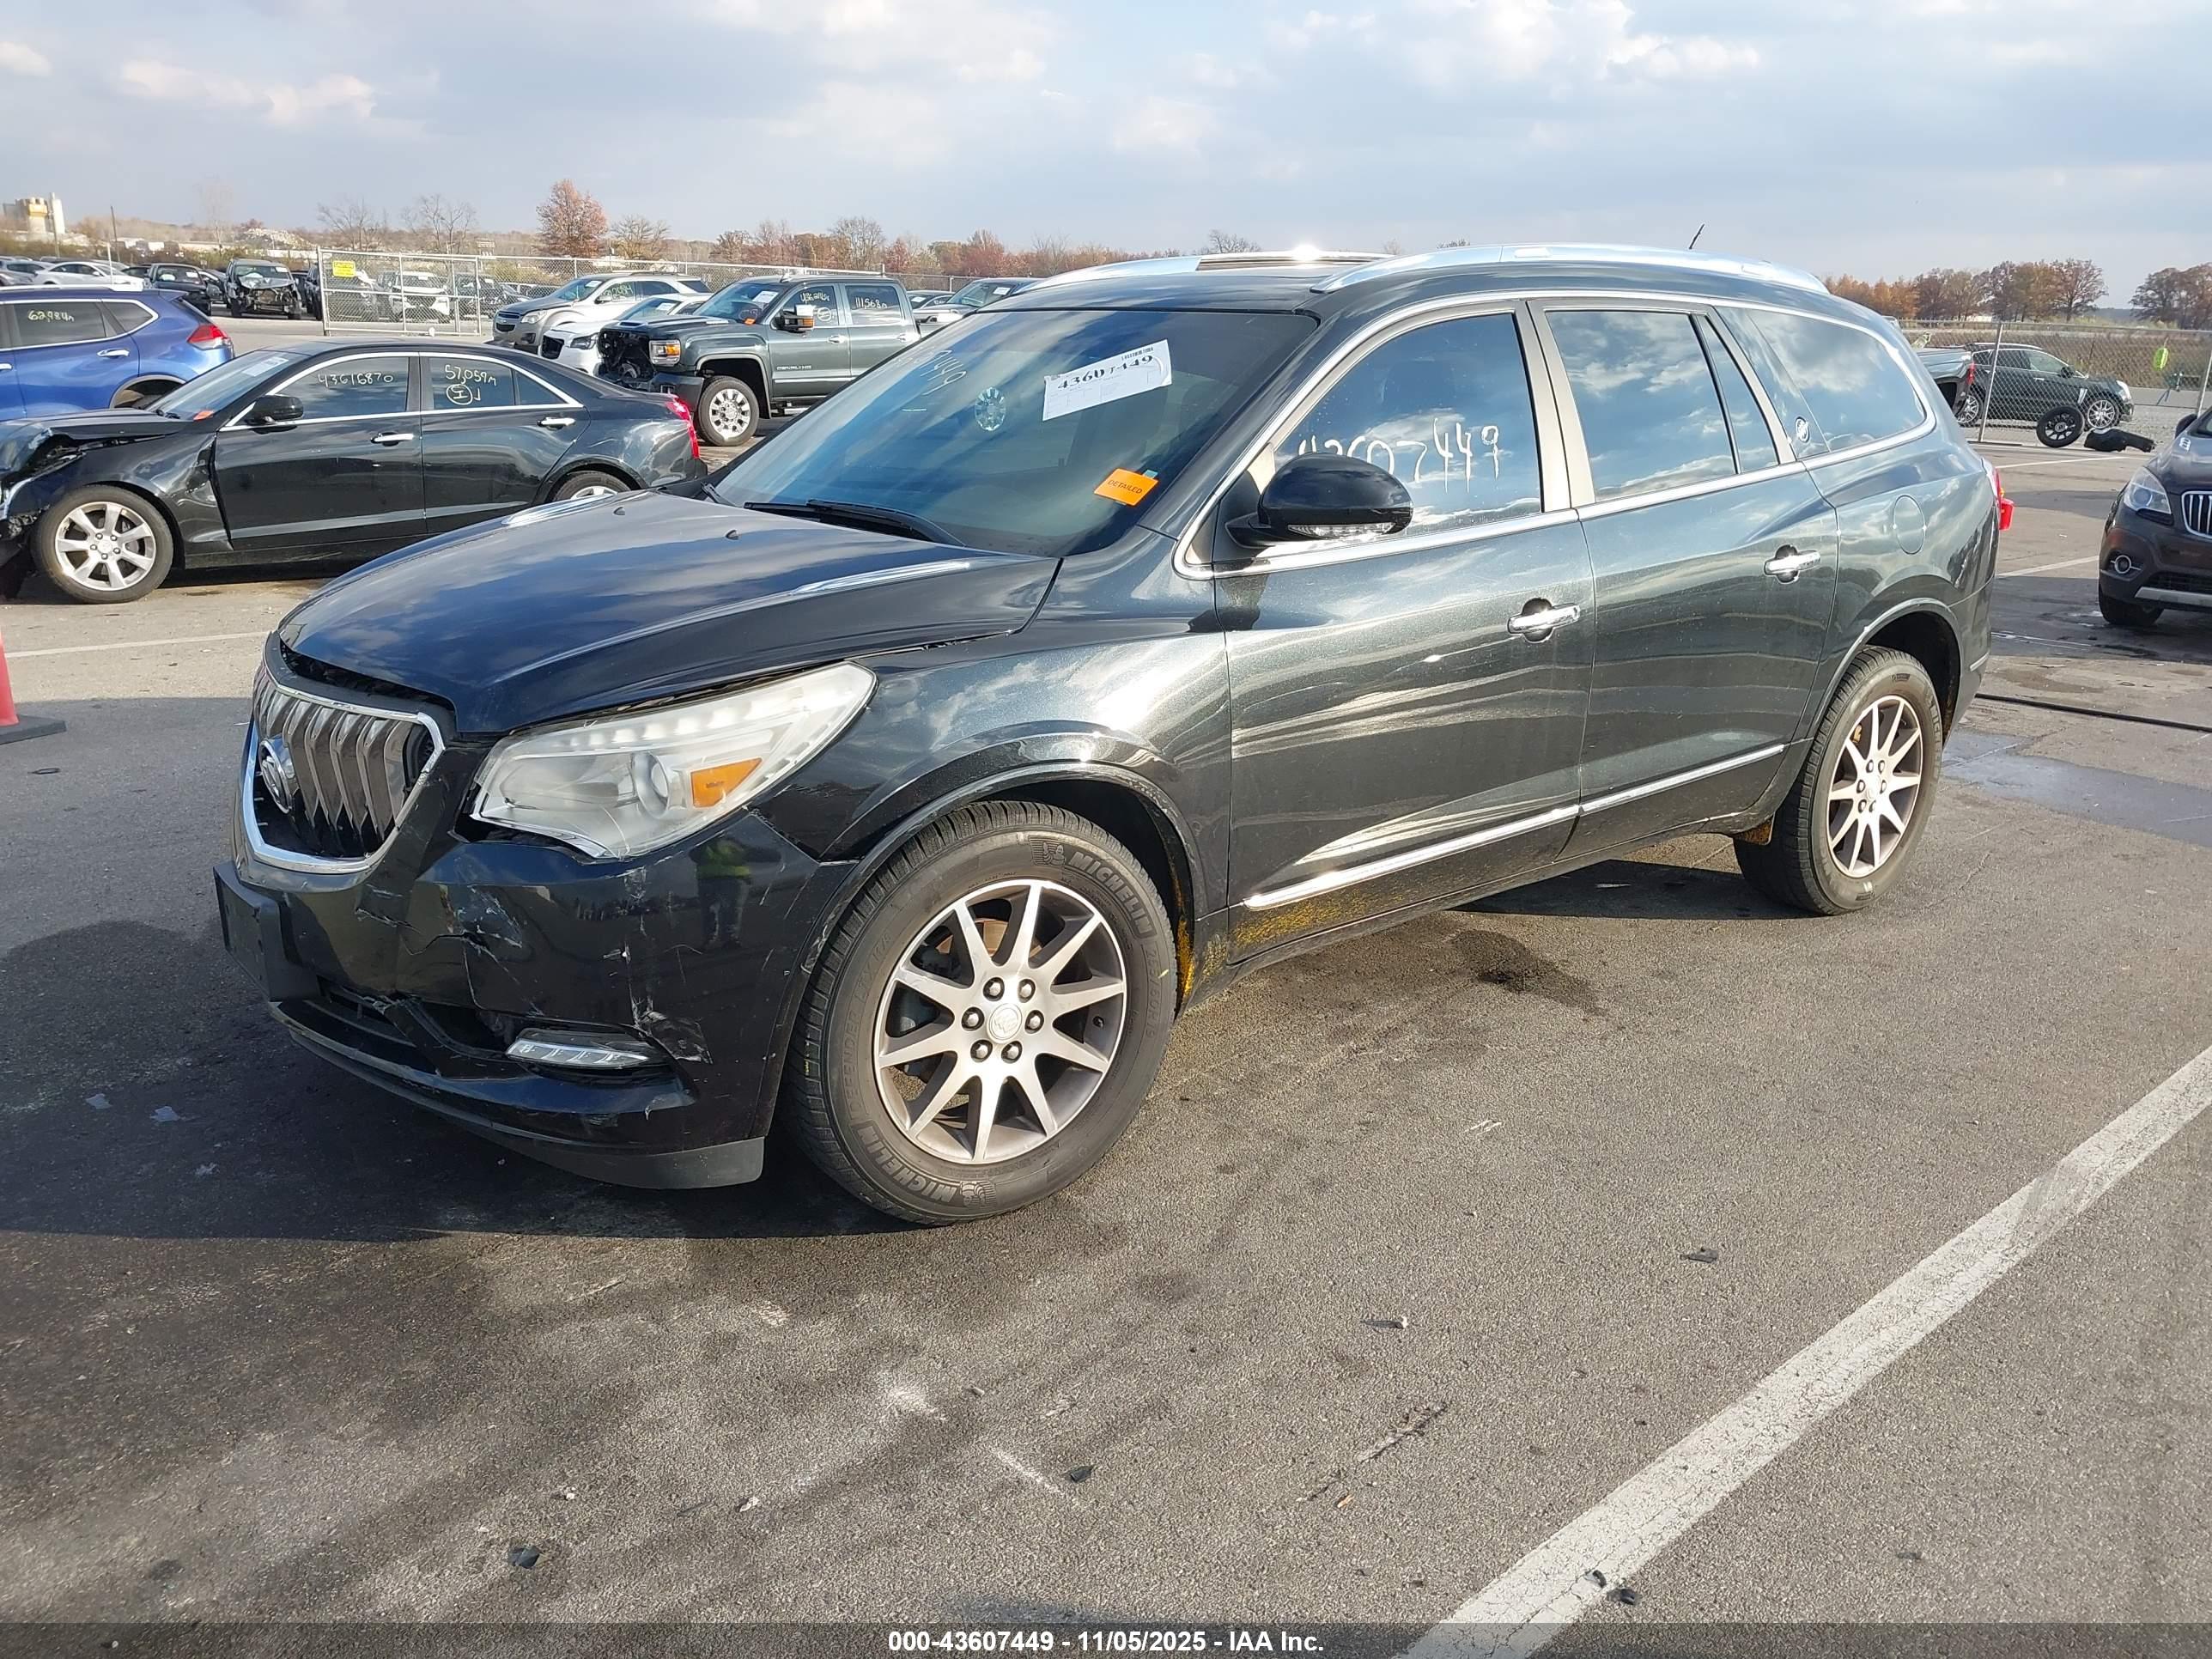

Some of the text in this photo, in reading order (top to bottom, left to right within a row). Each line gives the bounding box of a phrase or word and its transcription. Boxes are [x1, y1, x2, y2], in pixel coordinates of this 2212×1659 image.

[1107, 479, 1143, 495] DETAILED
[1070, 851, 1153, 934] MICHELIN
[857, 1125, 957, 1202] MICHELIN
